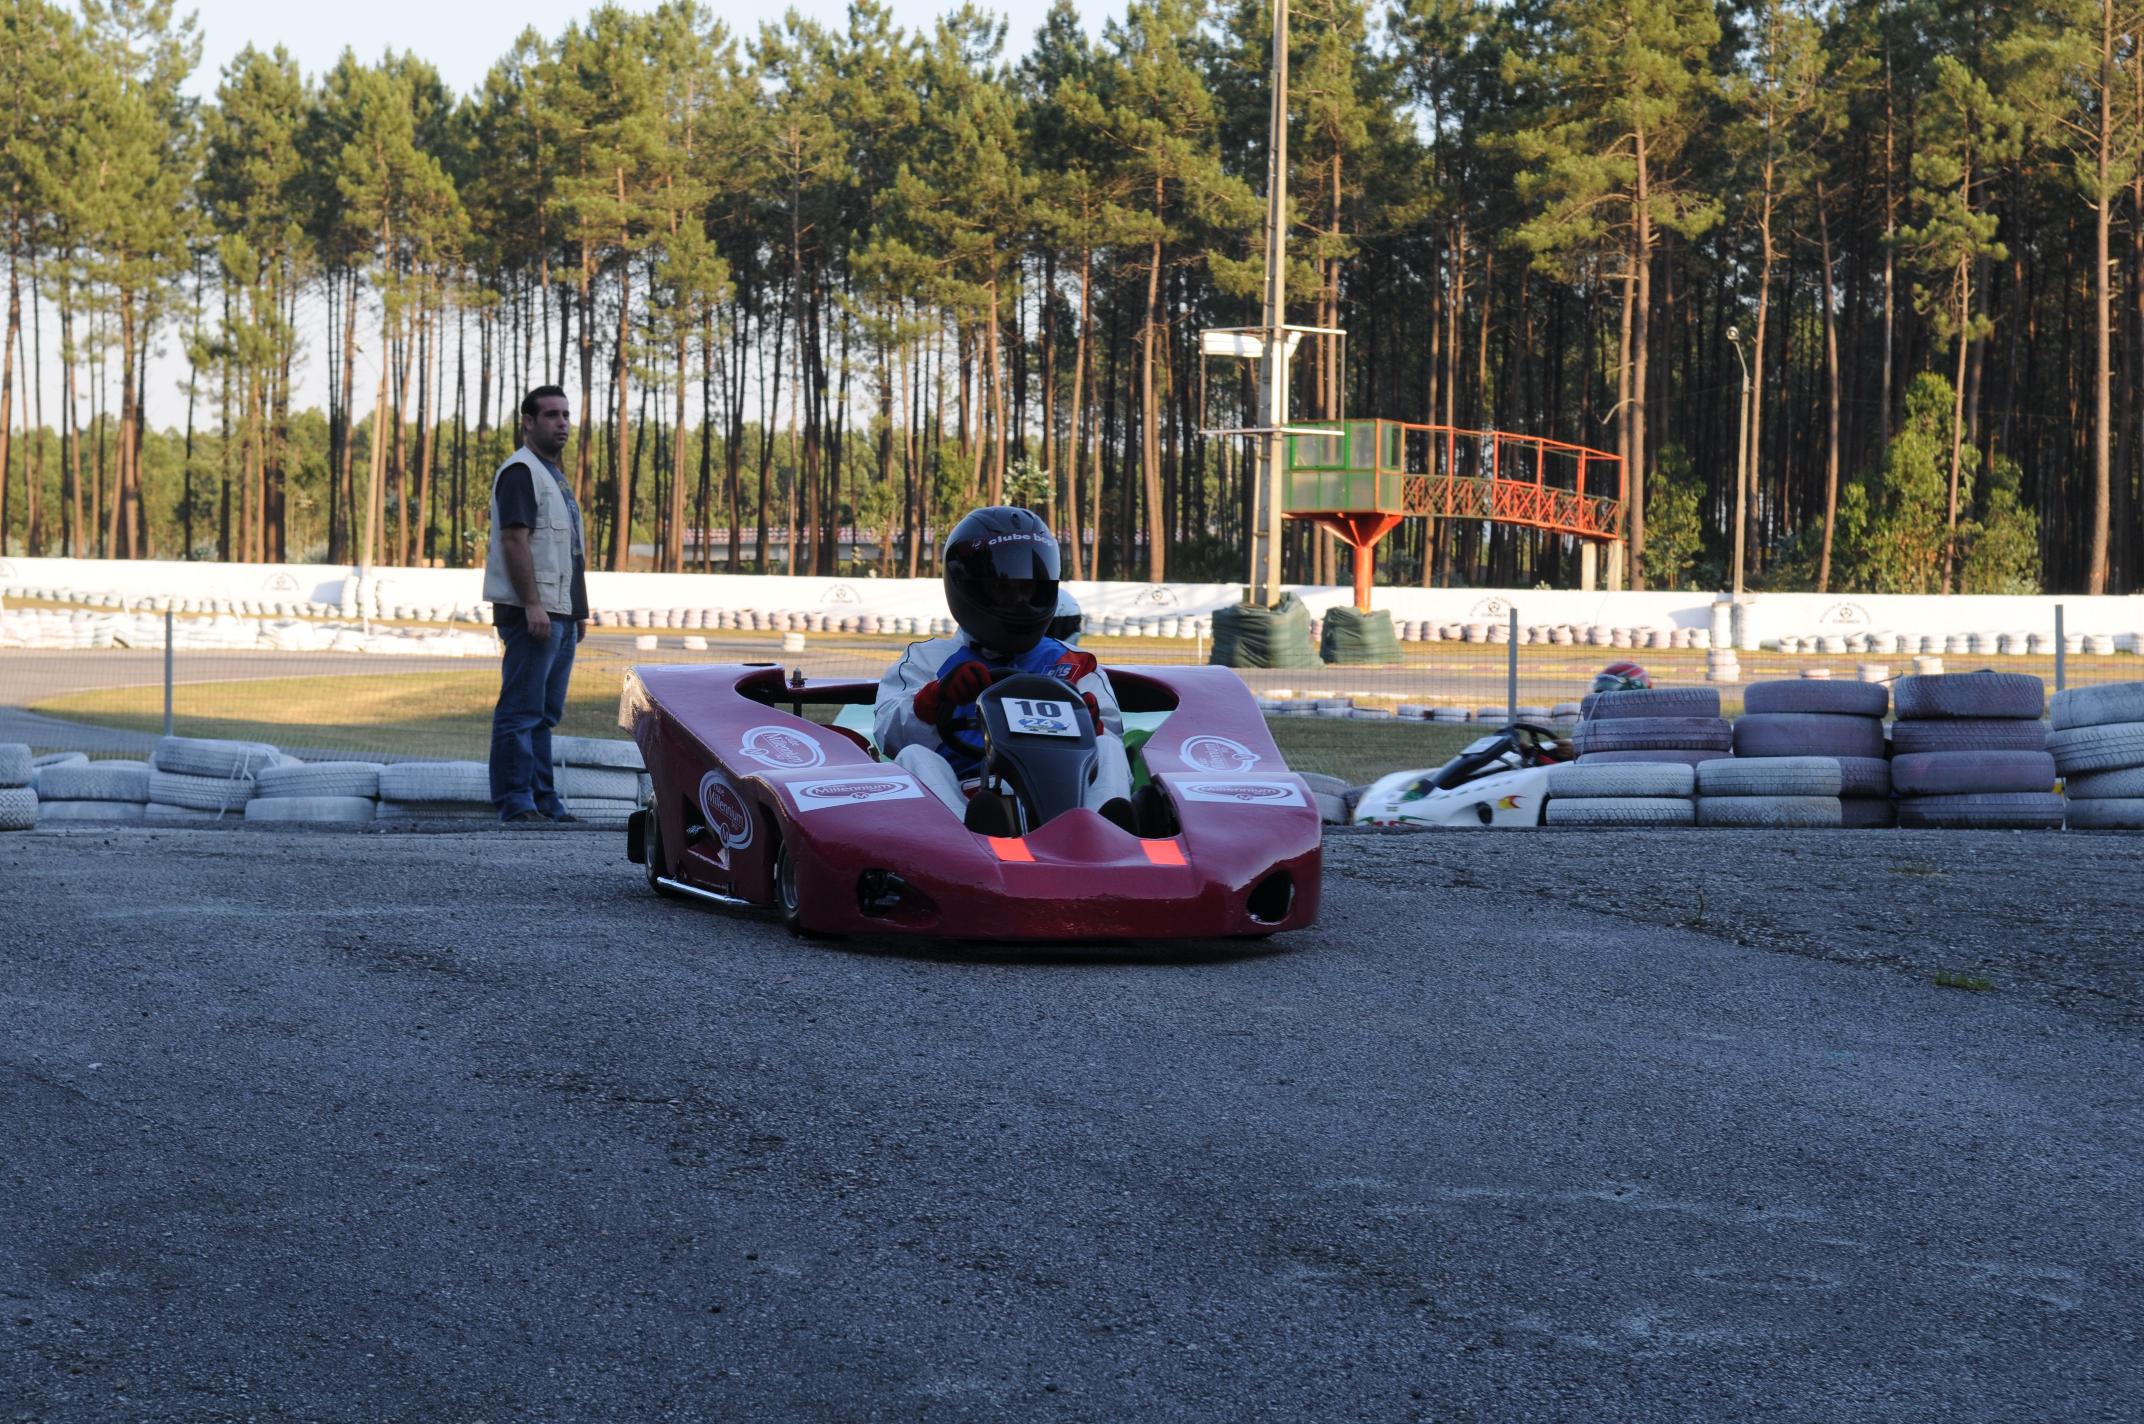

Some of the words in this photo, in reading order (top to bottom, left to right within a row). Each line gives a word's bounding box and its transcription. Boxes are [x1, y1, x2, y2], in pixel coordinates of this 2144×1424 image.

[988, 533, 1031, 546] clube
[1014, 700, 1062, 718] 10
[814, 783, 892, 795] Millennium
[707, 788, 744, 826] Millennium
